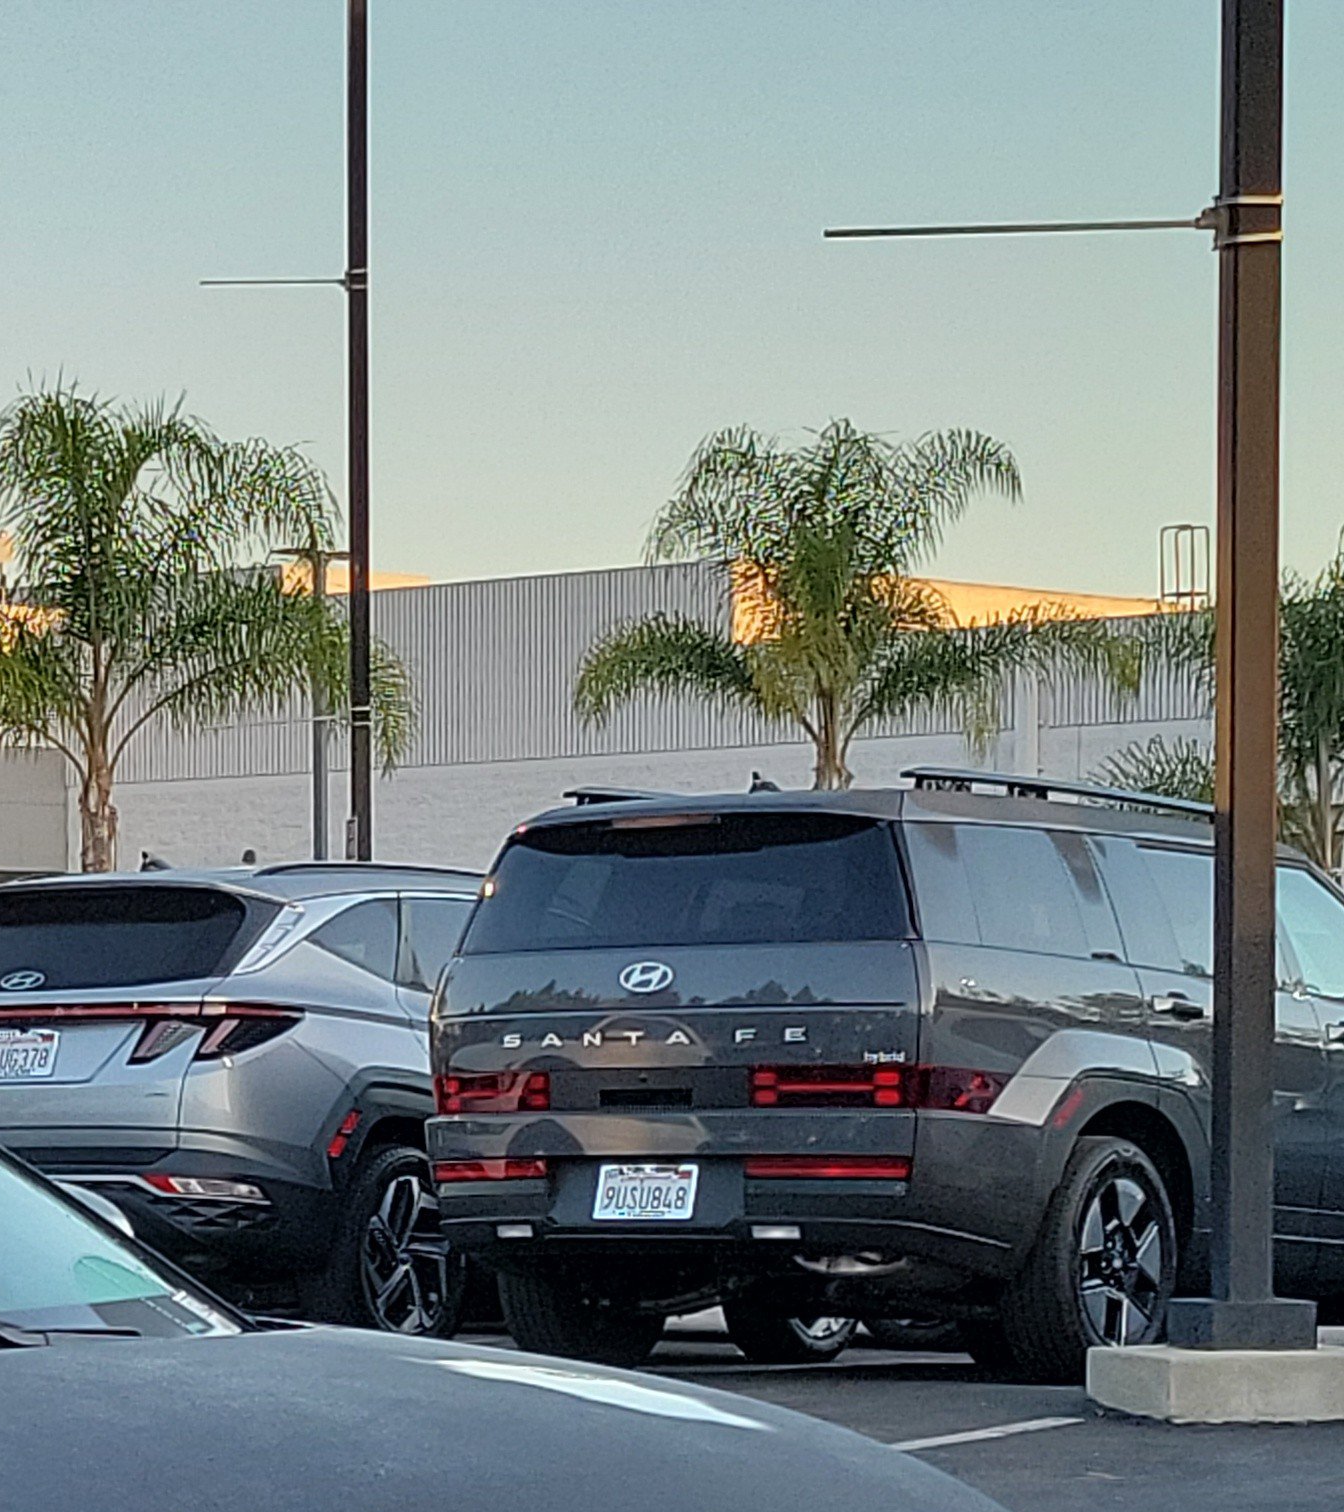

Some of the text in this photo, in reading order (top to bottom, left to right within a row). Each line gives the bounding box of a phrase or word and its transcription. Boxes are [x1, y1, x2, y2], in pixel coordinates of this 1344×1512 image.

[502, 1027, 808, 1049] SANTA FE
[863, 1050, 906, 1065] hybrid
[602, 1186, 687, 1210] 9USU848
